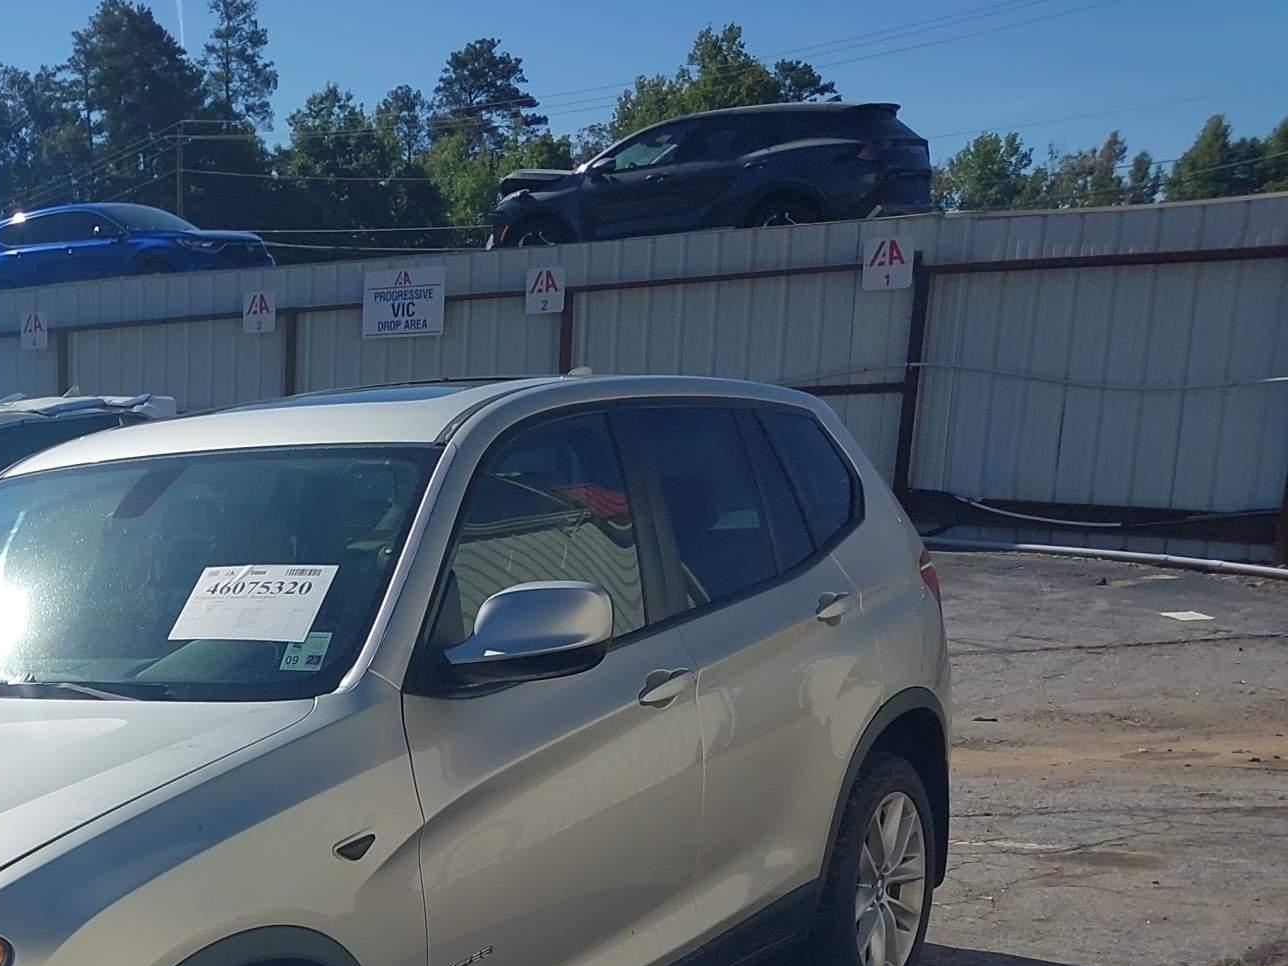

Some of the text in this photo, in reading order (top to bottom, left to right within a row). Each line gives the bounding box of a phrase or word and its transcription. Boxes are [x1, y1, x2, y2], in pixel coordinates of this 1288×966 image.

[882, 274, 890, 287] 1
[374, 288, 434, 302] PROGRESSIVE
[392, 302, 415, 318] VIC
[541, 300, 548, 311] 2
[377, 319, 428, 332] DROP AREA
[206, 581, 313, 596] 46075320
[285, 655, 322, 665] 09 23
